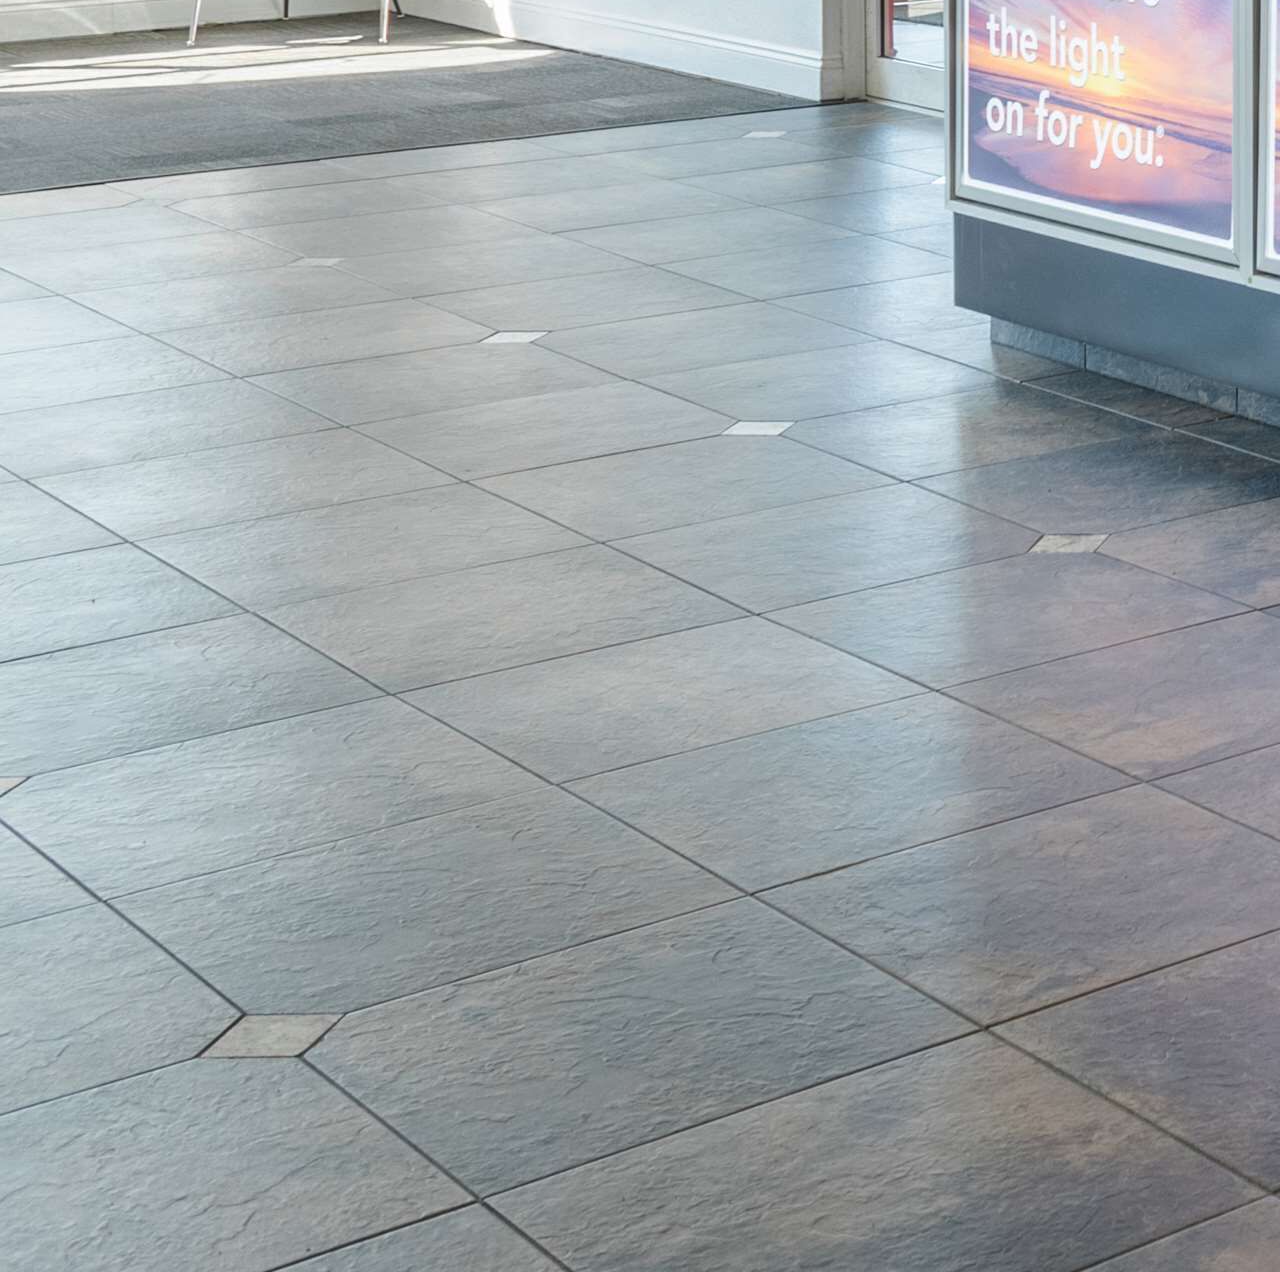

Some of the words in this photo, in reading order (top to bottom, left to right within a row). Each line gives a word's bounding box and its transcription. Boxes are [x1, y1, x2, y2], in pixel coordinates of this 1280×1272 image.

[986, 6, 1038, 63] the
[1049, 15, 1126, 88] light
[985, 96, 1024, 137] on
[1035, 90, 1083, 148] for
